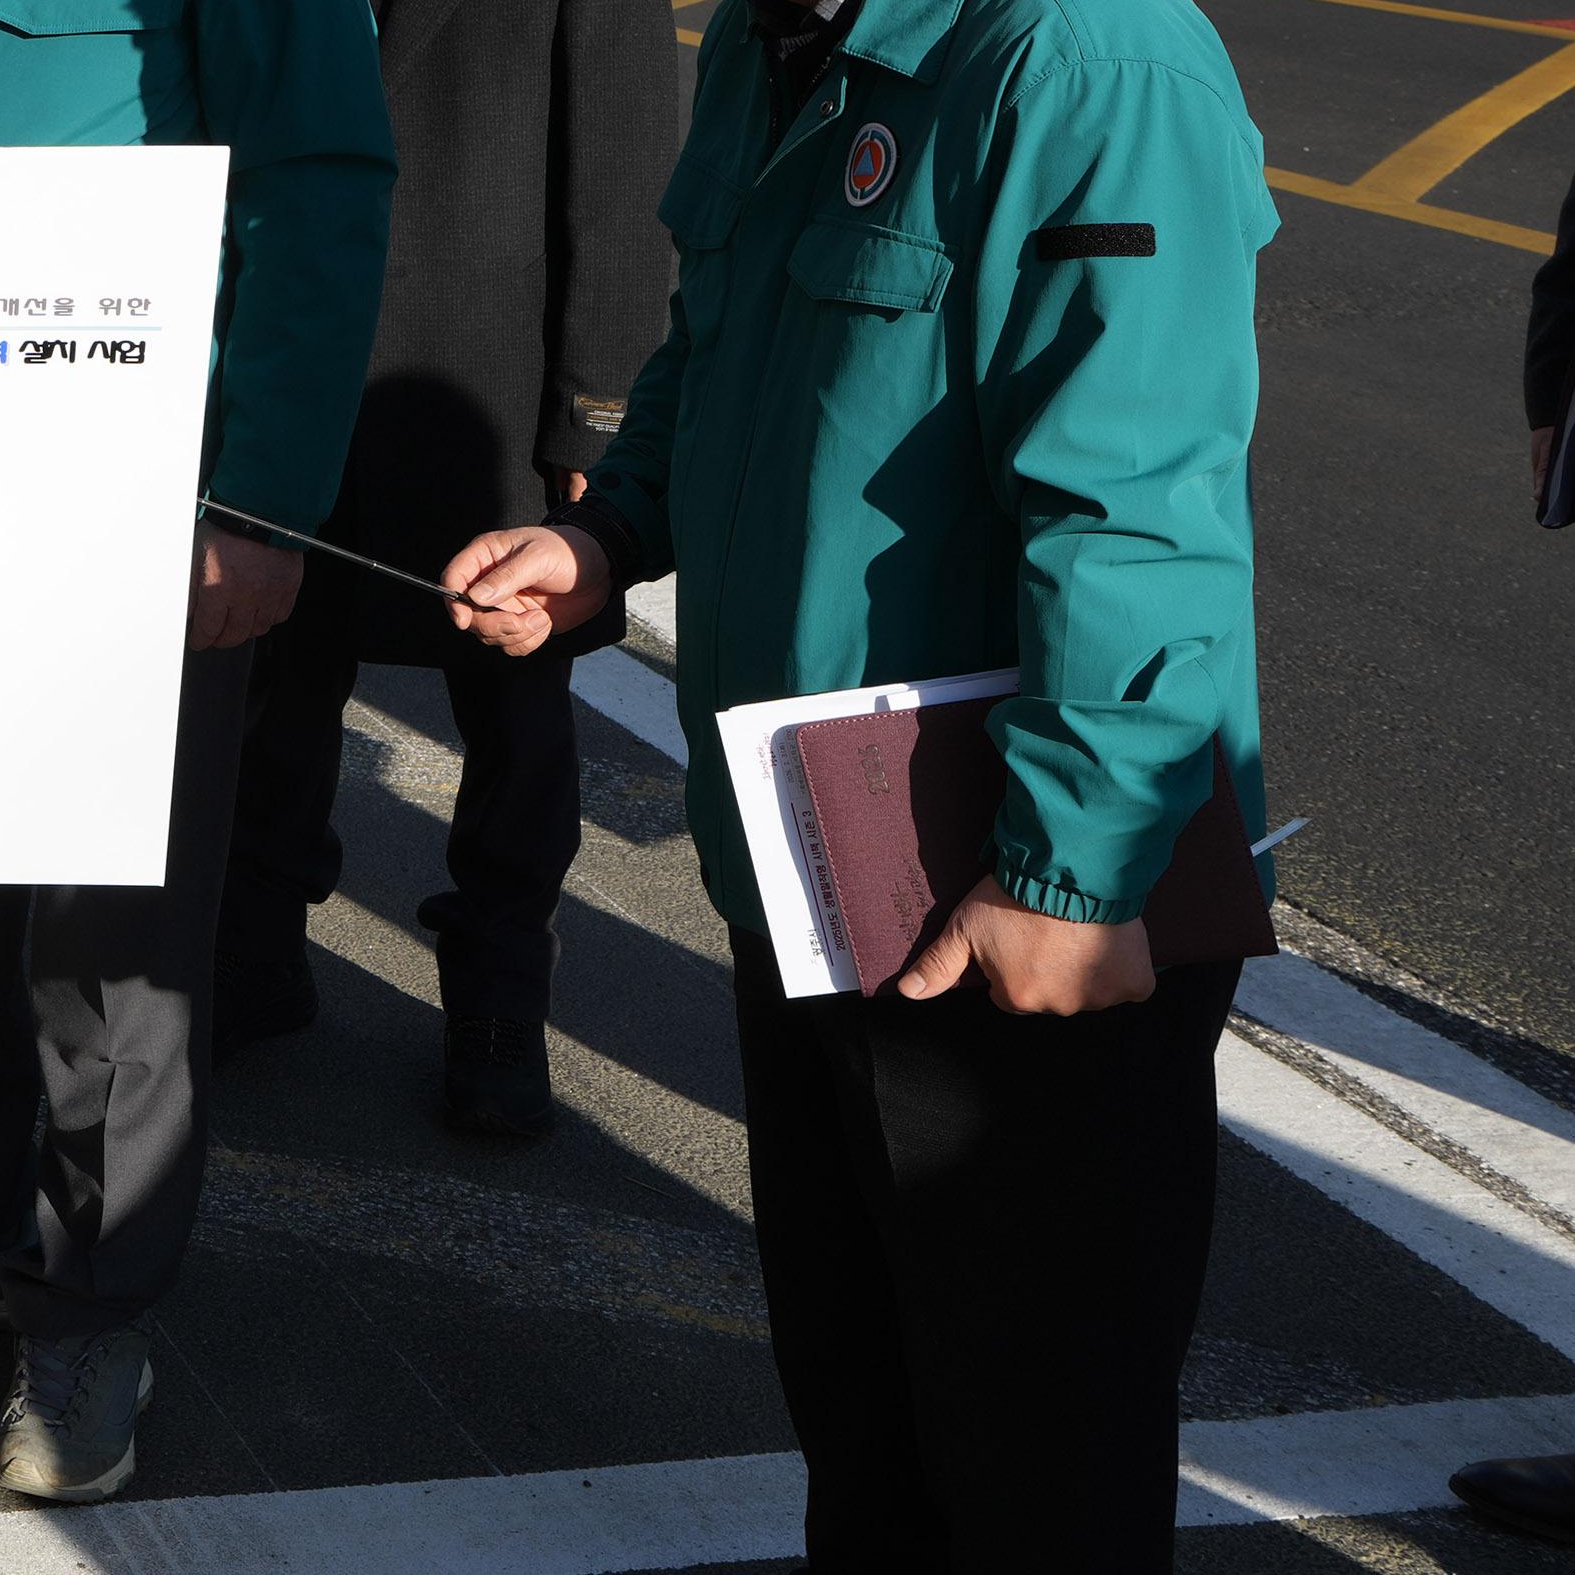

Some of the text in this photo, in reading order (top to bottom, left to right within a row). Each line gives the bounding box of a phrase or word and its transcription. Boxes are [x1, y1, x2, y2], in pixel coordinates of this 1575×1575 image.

[97, 296, 153, 319] 위한
[18, 339, 77, 365] 설치
[86, 339, 147, 365] 사업
[828, 913, 847, 952] 2025년도
